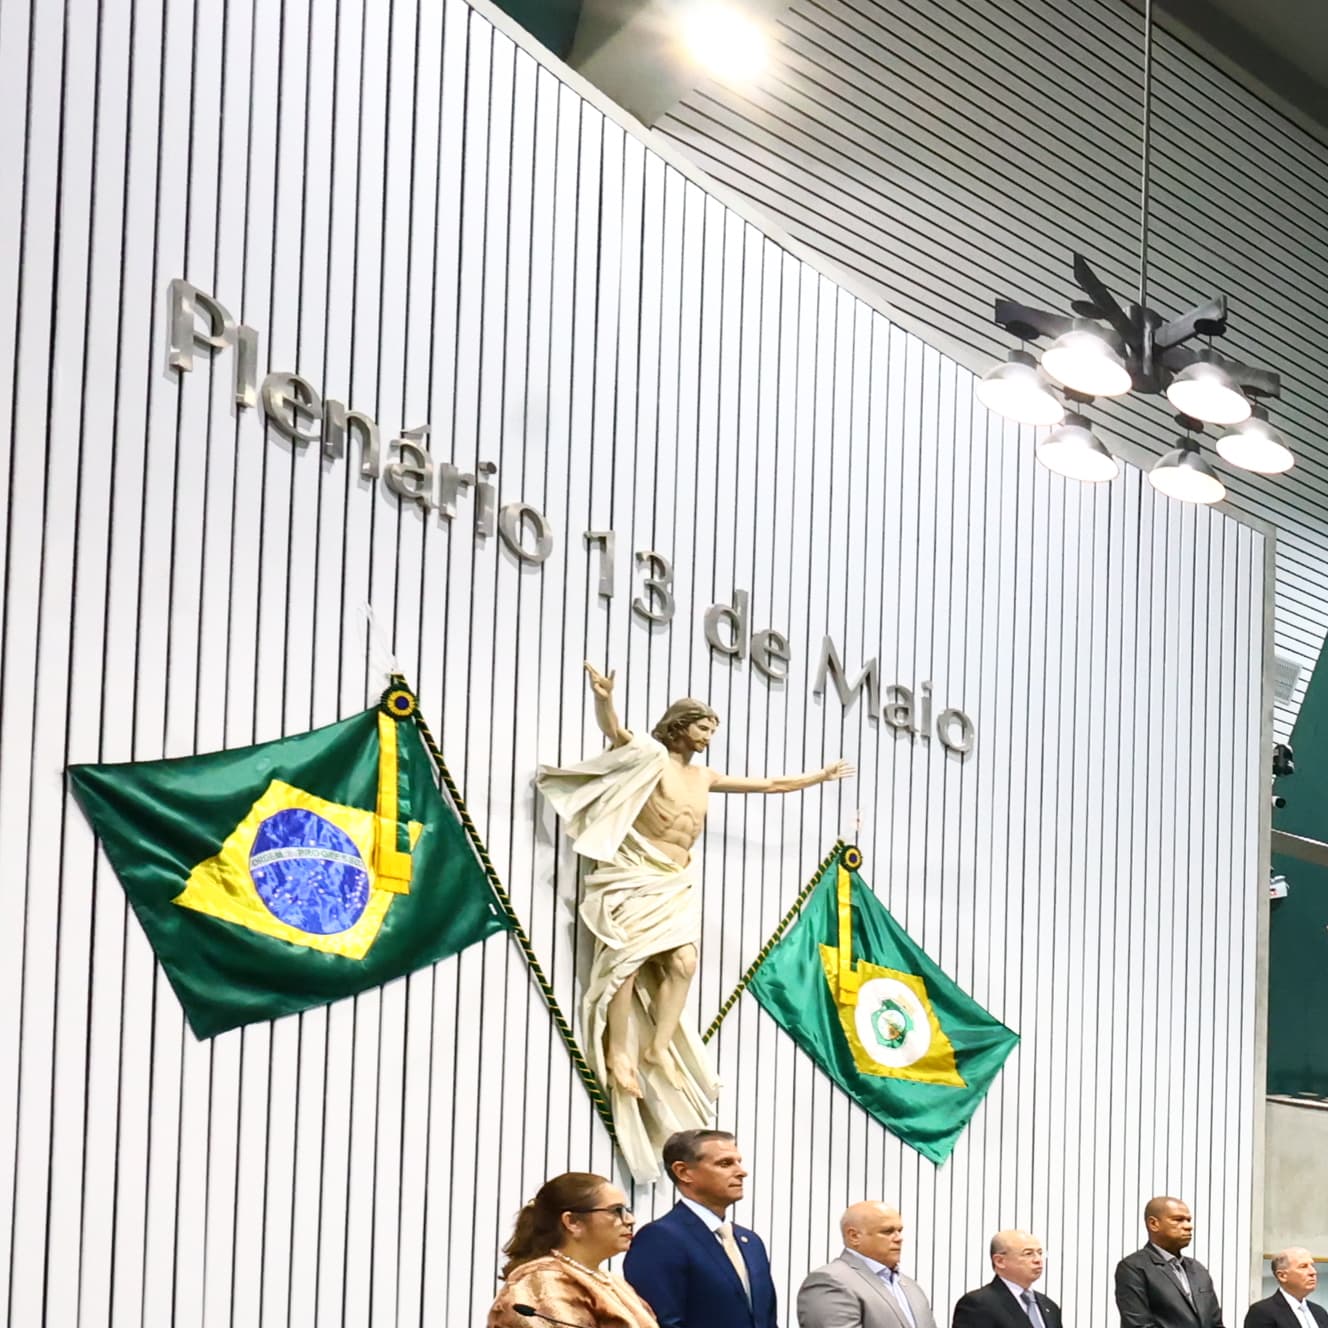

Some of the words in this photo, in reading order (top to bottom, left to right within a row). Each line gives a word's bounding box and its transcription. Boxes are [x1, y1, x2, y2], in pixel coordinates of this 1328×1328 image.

[168, 278, 553, 565] Plenário
[584, 530, 676, 626] 13
[705, 589, 793, 681] de
[814, 634, 975, 757] Maio
